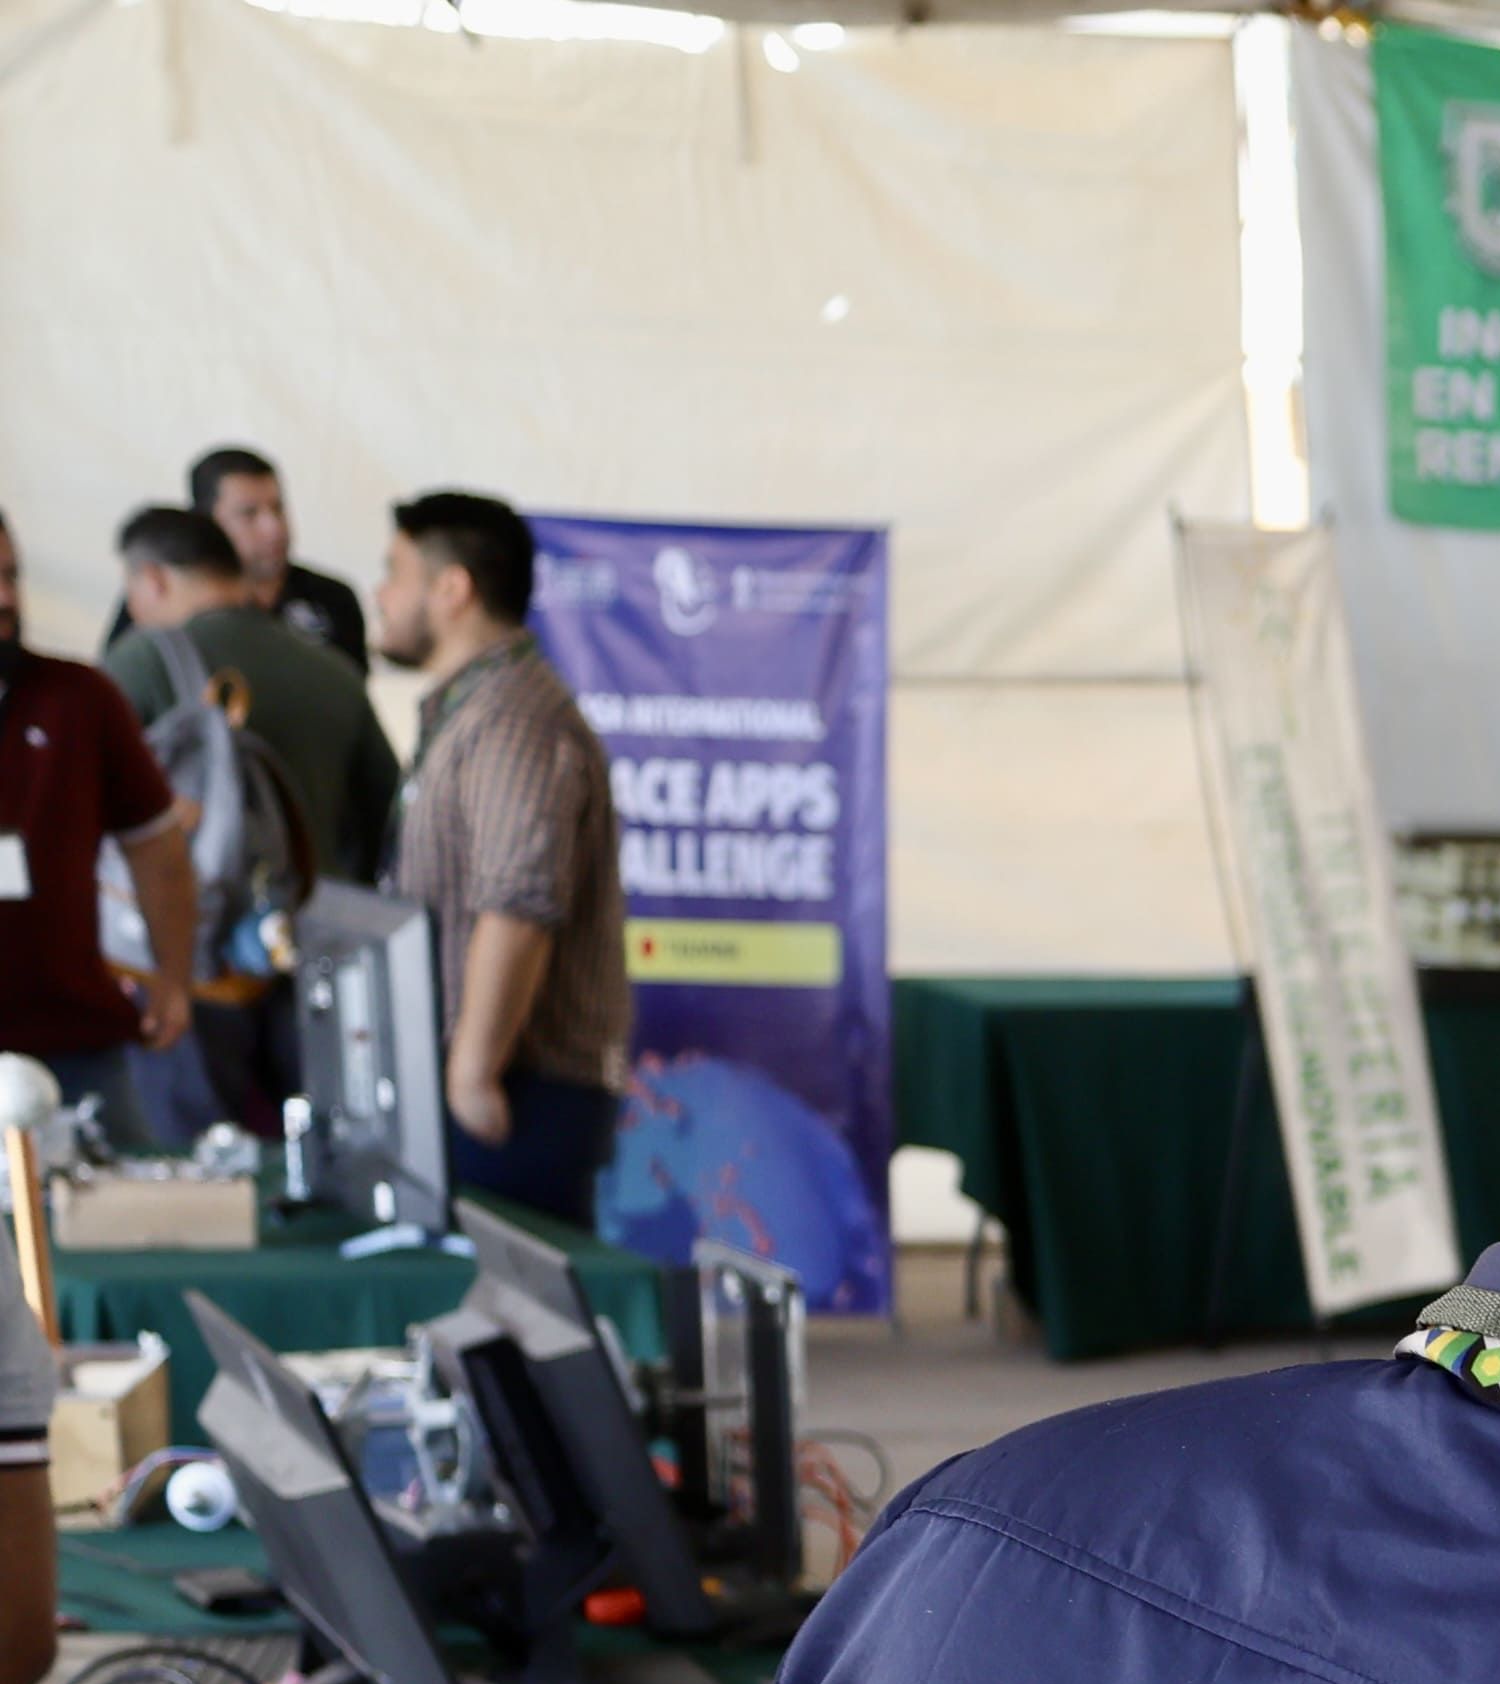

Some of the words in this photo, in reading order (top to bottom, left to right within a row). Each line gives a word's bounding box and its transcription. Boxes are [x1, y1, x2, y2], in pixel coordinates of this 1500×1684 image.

[1411, 365, 1495, 421] EN
[612, 757, 703, 823] ACE
[705, 760, 841, 831] APPS
[620, 831, 835, 901] ALLENGE
